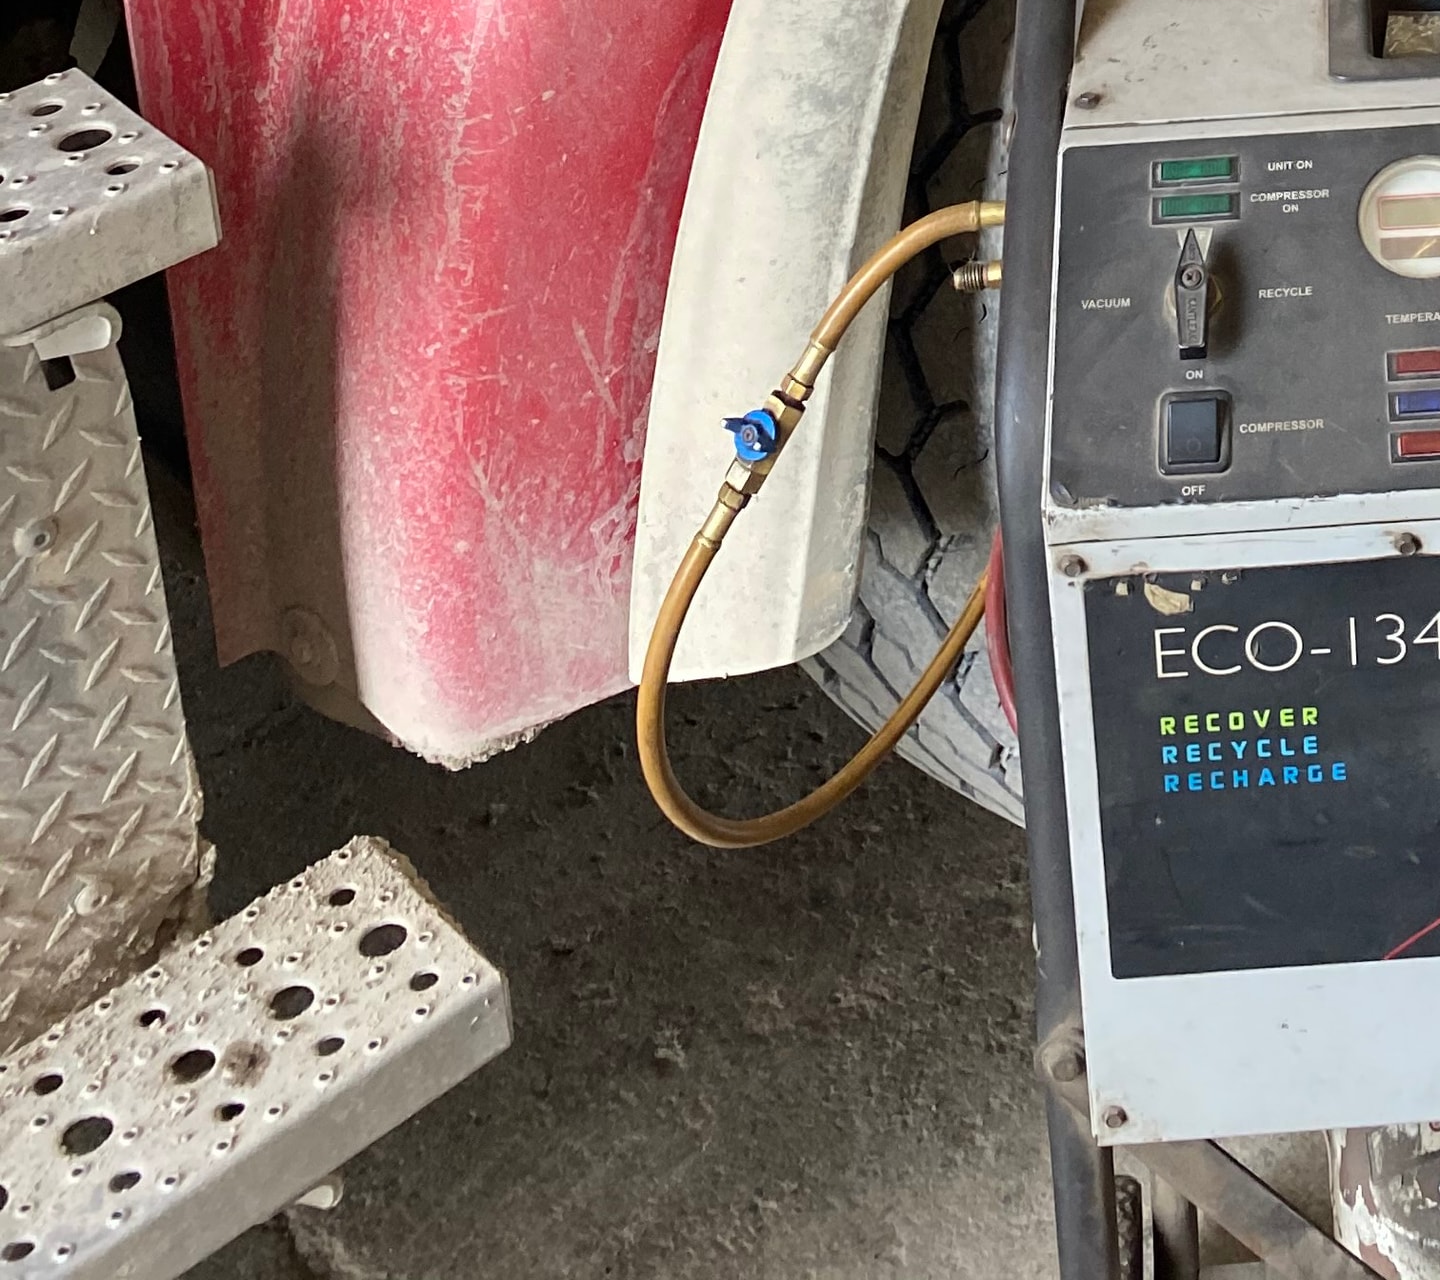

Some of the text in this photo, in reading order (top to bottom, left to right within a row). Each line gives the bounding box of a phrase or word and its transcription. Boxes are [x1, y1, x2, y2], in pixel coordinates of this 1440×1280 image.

[1267, 159, 1313, 171] UNIT ON
[1250, 189, 1329, 203] COMPRESSOR
[1282, 203, 1298, 214] ON
[1258, 286, 1312, 299] RECYCLE
[1081, 297, 1130, 309] VACUUM
[1185, 369, 1203, 380] ON
[1240, 419, 1324, 434] COMPRESSOR
[1181, 485, 1205, 496] OFF
[1160, 707, 1319, 735] RECOVER
[1162, 736, 1319, 764] RECYCLE
[1164, 763, 1347, 792] RECHARGE
